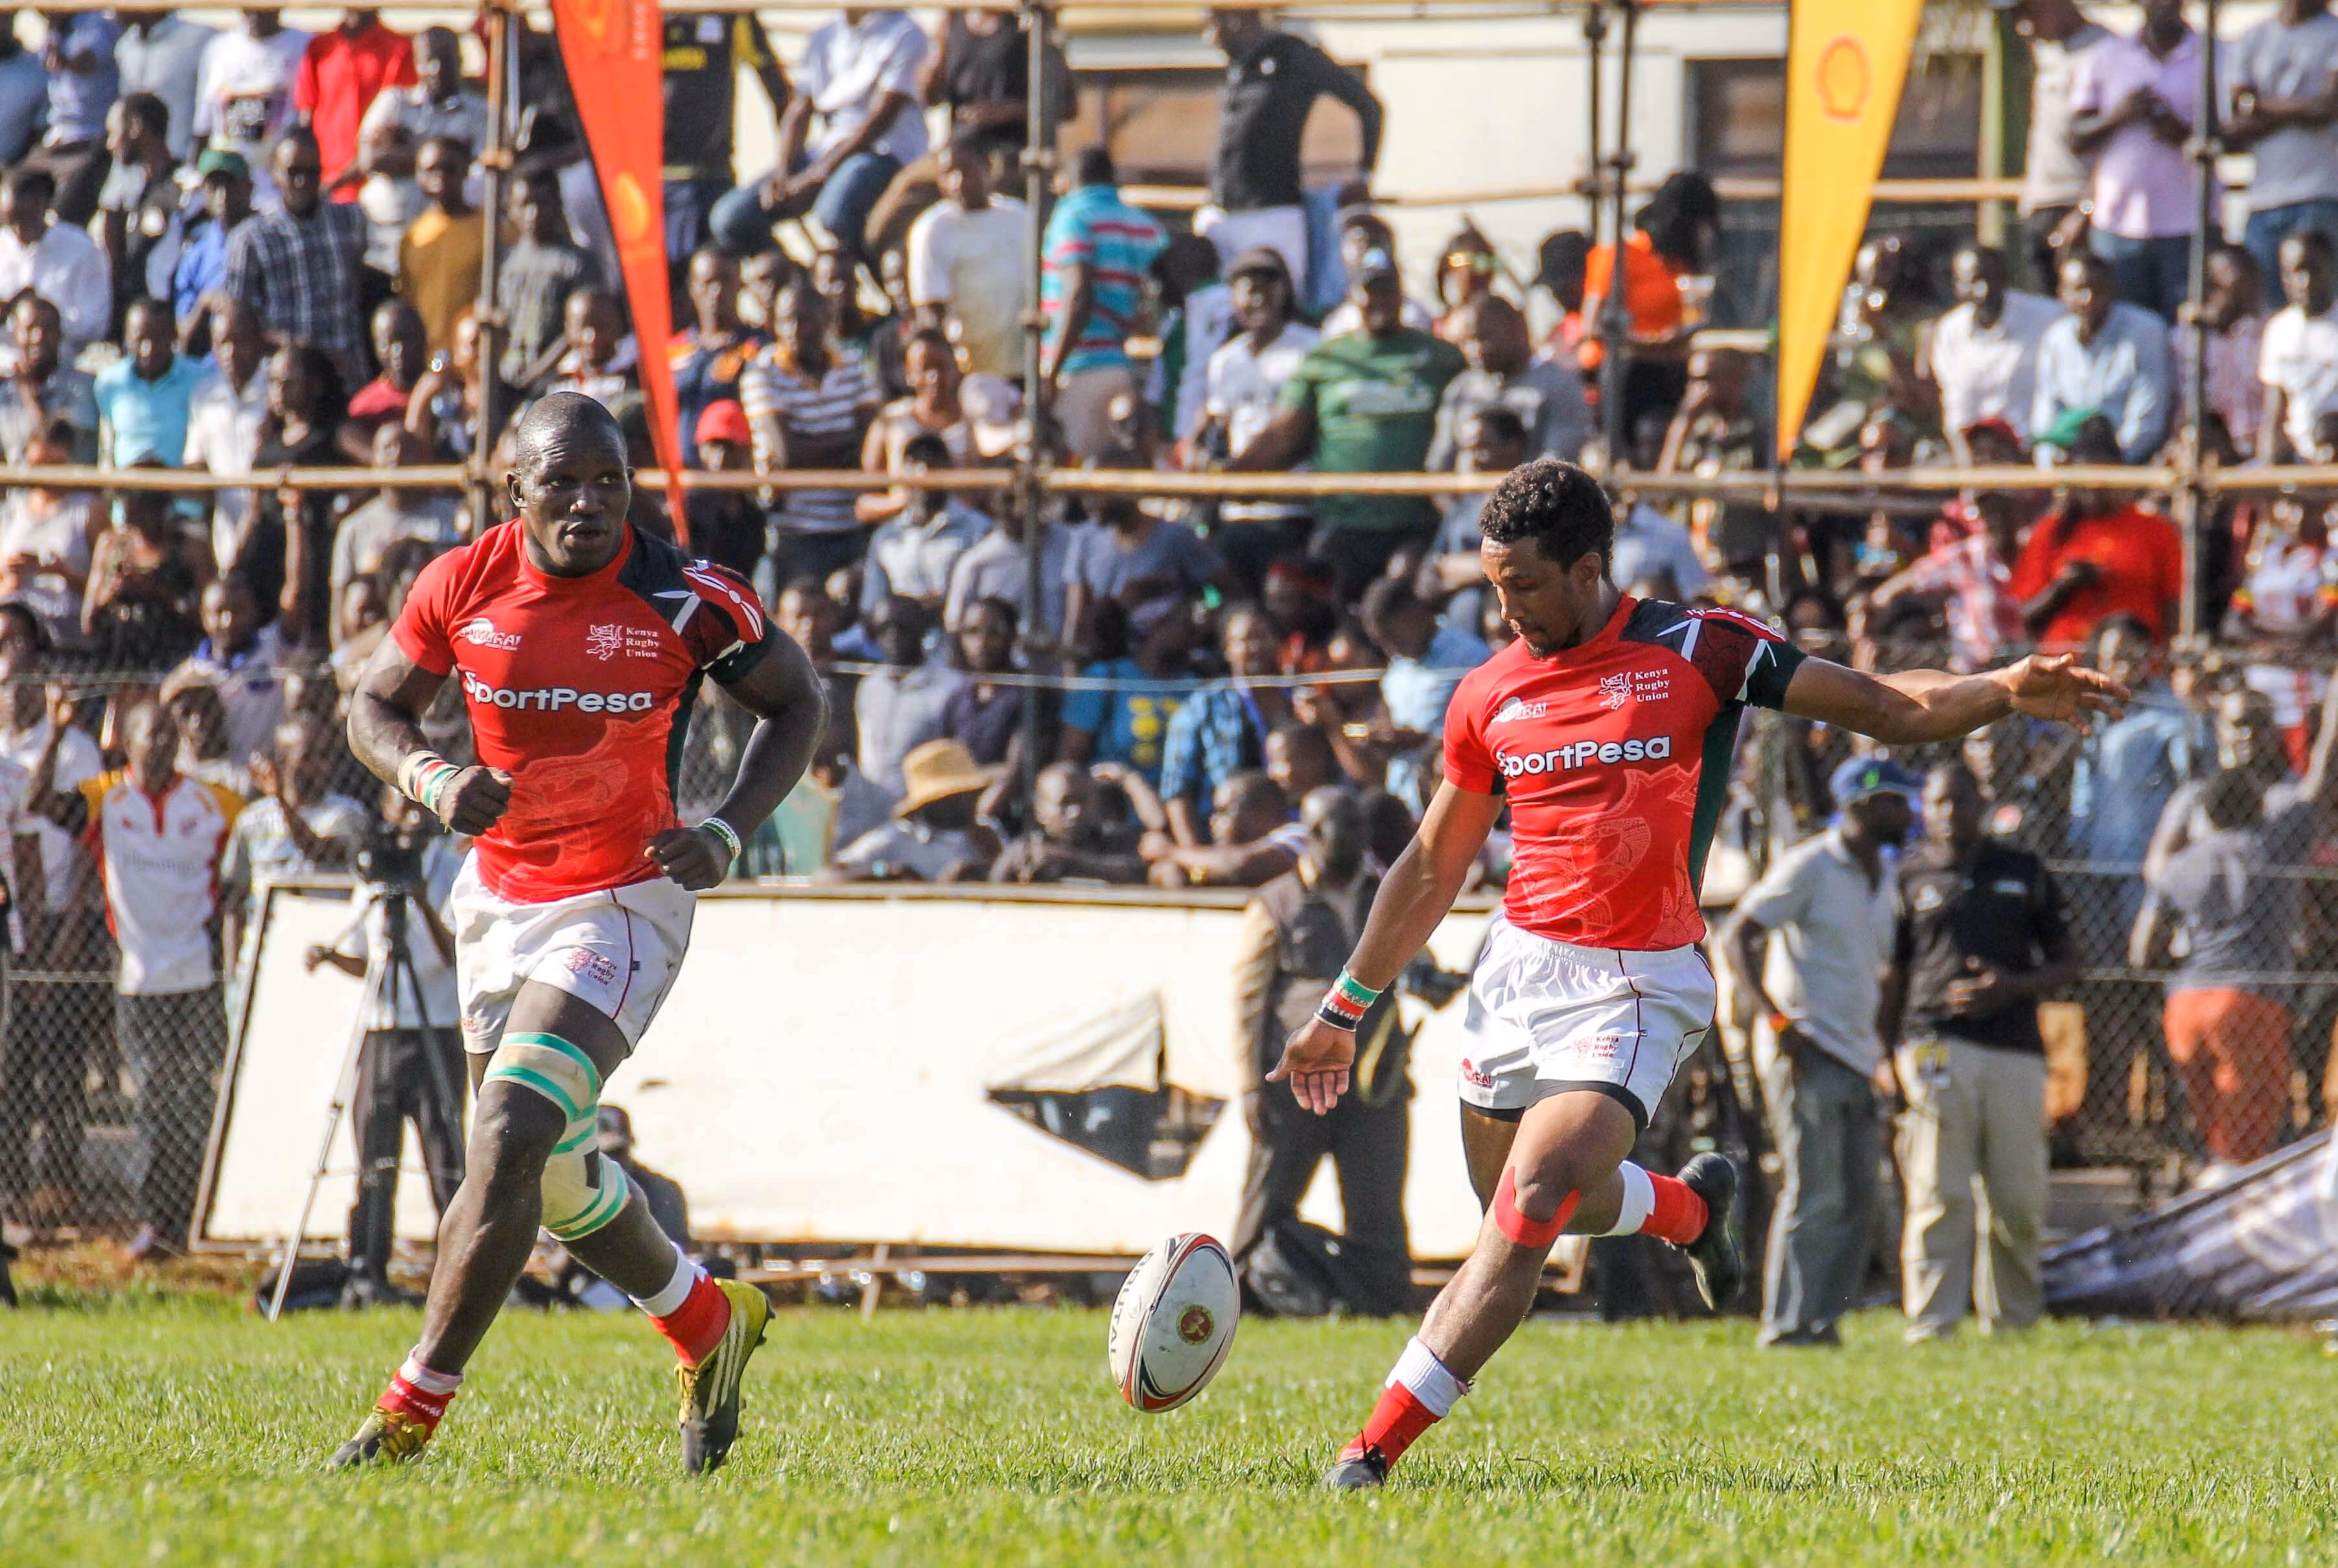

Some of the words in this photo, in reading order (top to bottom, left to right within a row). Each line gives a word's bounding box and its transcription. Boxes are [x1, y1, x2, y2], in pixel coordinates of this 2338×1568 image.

[626, 627, 659, 637] Kenya
[625, 638, 659, 648] Rugby
[626, 649, 657, 657] Union
[1635, 668, 1668, 680] Kenya
[1636, 679, 1670, 692] Rugby
[465, 671, 652, 713] SportPesa
[1637, 692, 1668, 702] Union
[592, 963, 615, 979] Rugby
[587, 970, 609, 985] Union
